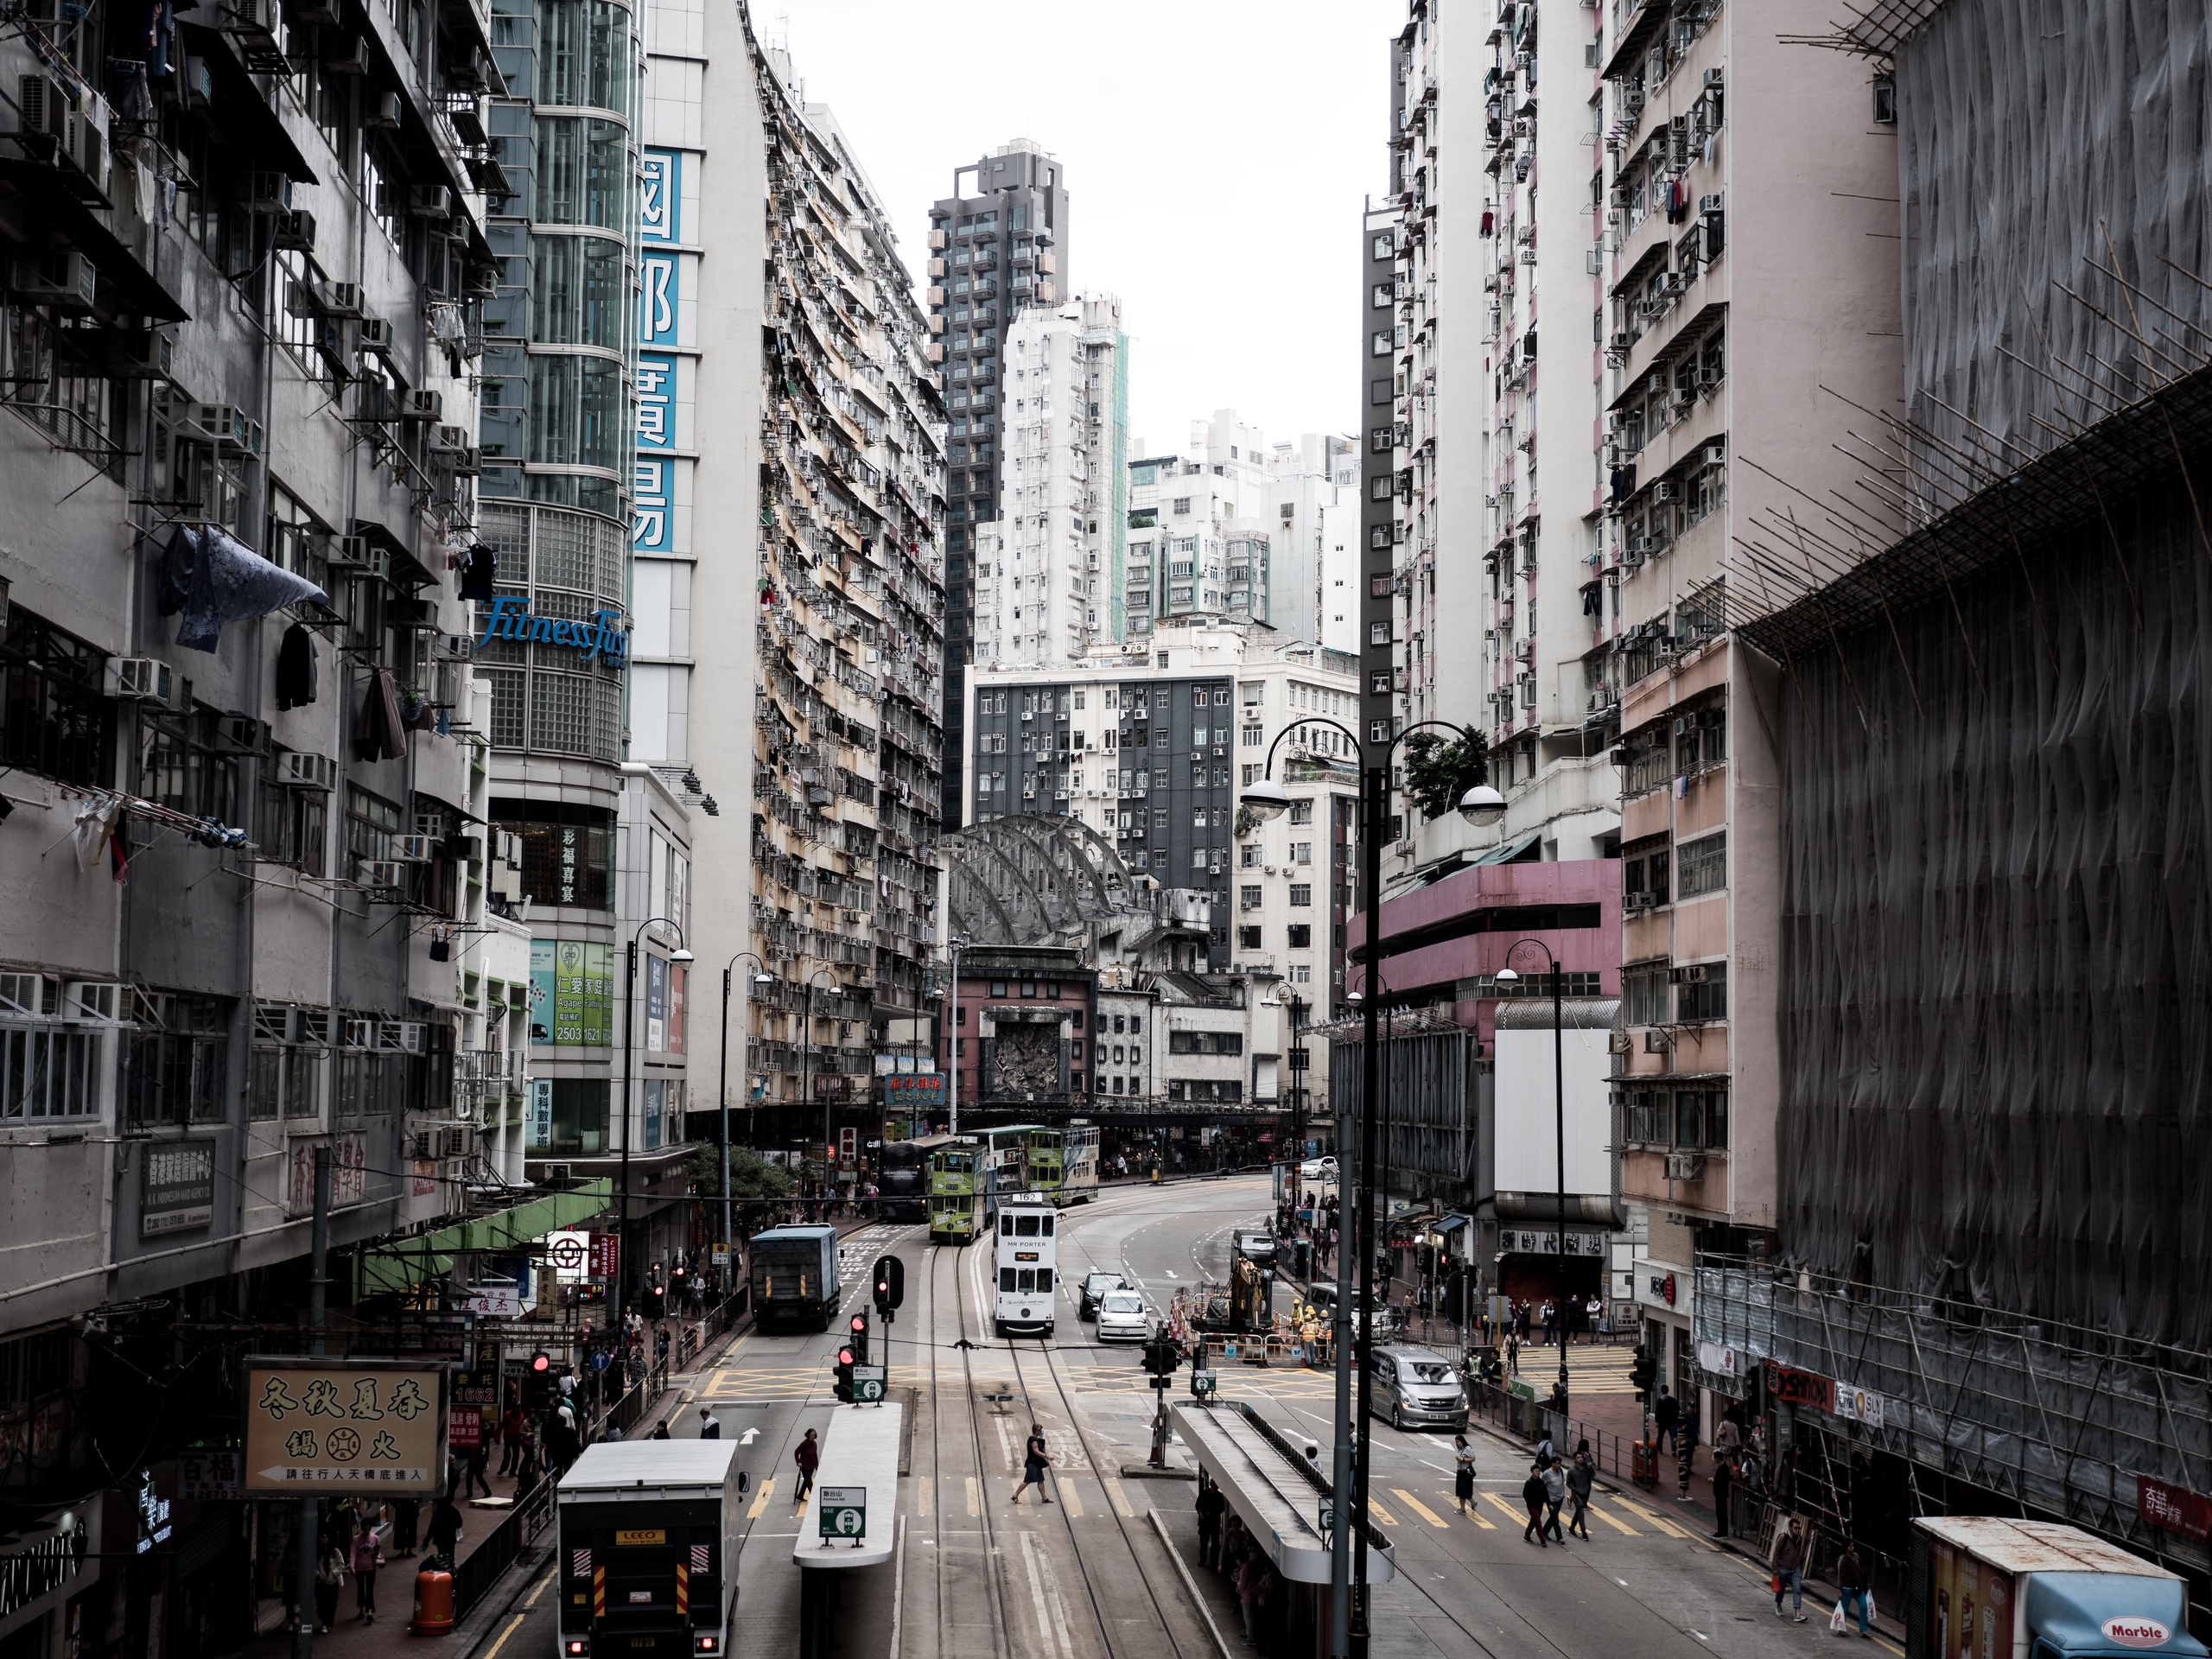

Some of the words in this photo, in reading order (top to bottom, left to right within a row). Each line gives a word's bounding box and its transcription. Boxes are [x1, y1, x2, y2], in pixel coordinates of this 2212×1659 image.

[475, 597, 592, 648] Fitness
[580, 610, 627, 660] First
[562, 829, 575, 902] 彩福喜宴
[557, 998, 582, 1009] Agape
[584, 998, 602, 1010] Family
[557, 1027, 582, 1040] 2503
[584, 1027, 600, 1041] 1621
[537, 1084, 549, 1148] 專科數學班
[1501, 1230, 1601, 1253] 新時代廣場
[479, 1344, 496, 1361] 產
[455, 1387, 495, 1402] 1662
[286, 1469, 422, 1480] 請往行人天橋底進入
[2111, 1624, 2163, 1638] Marble
